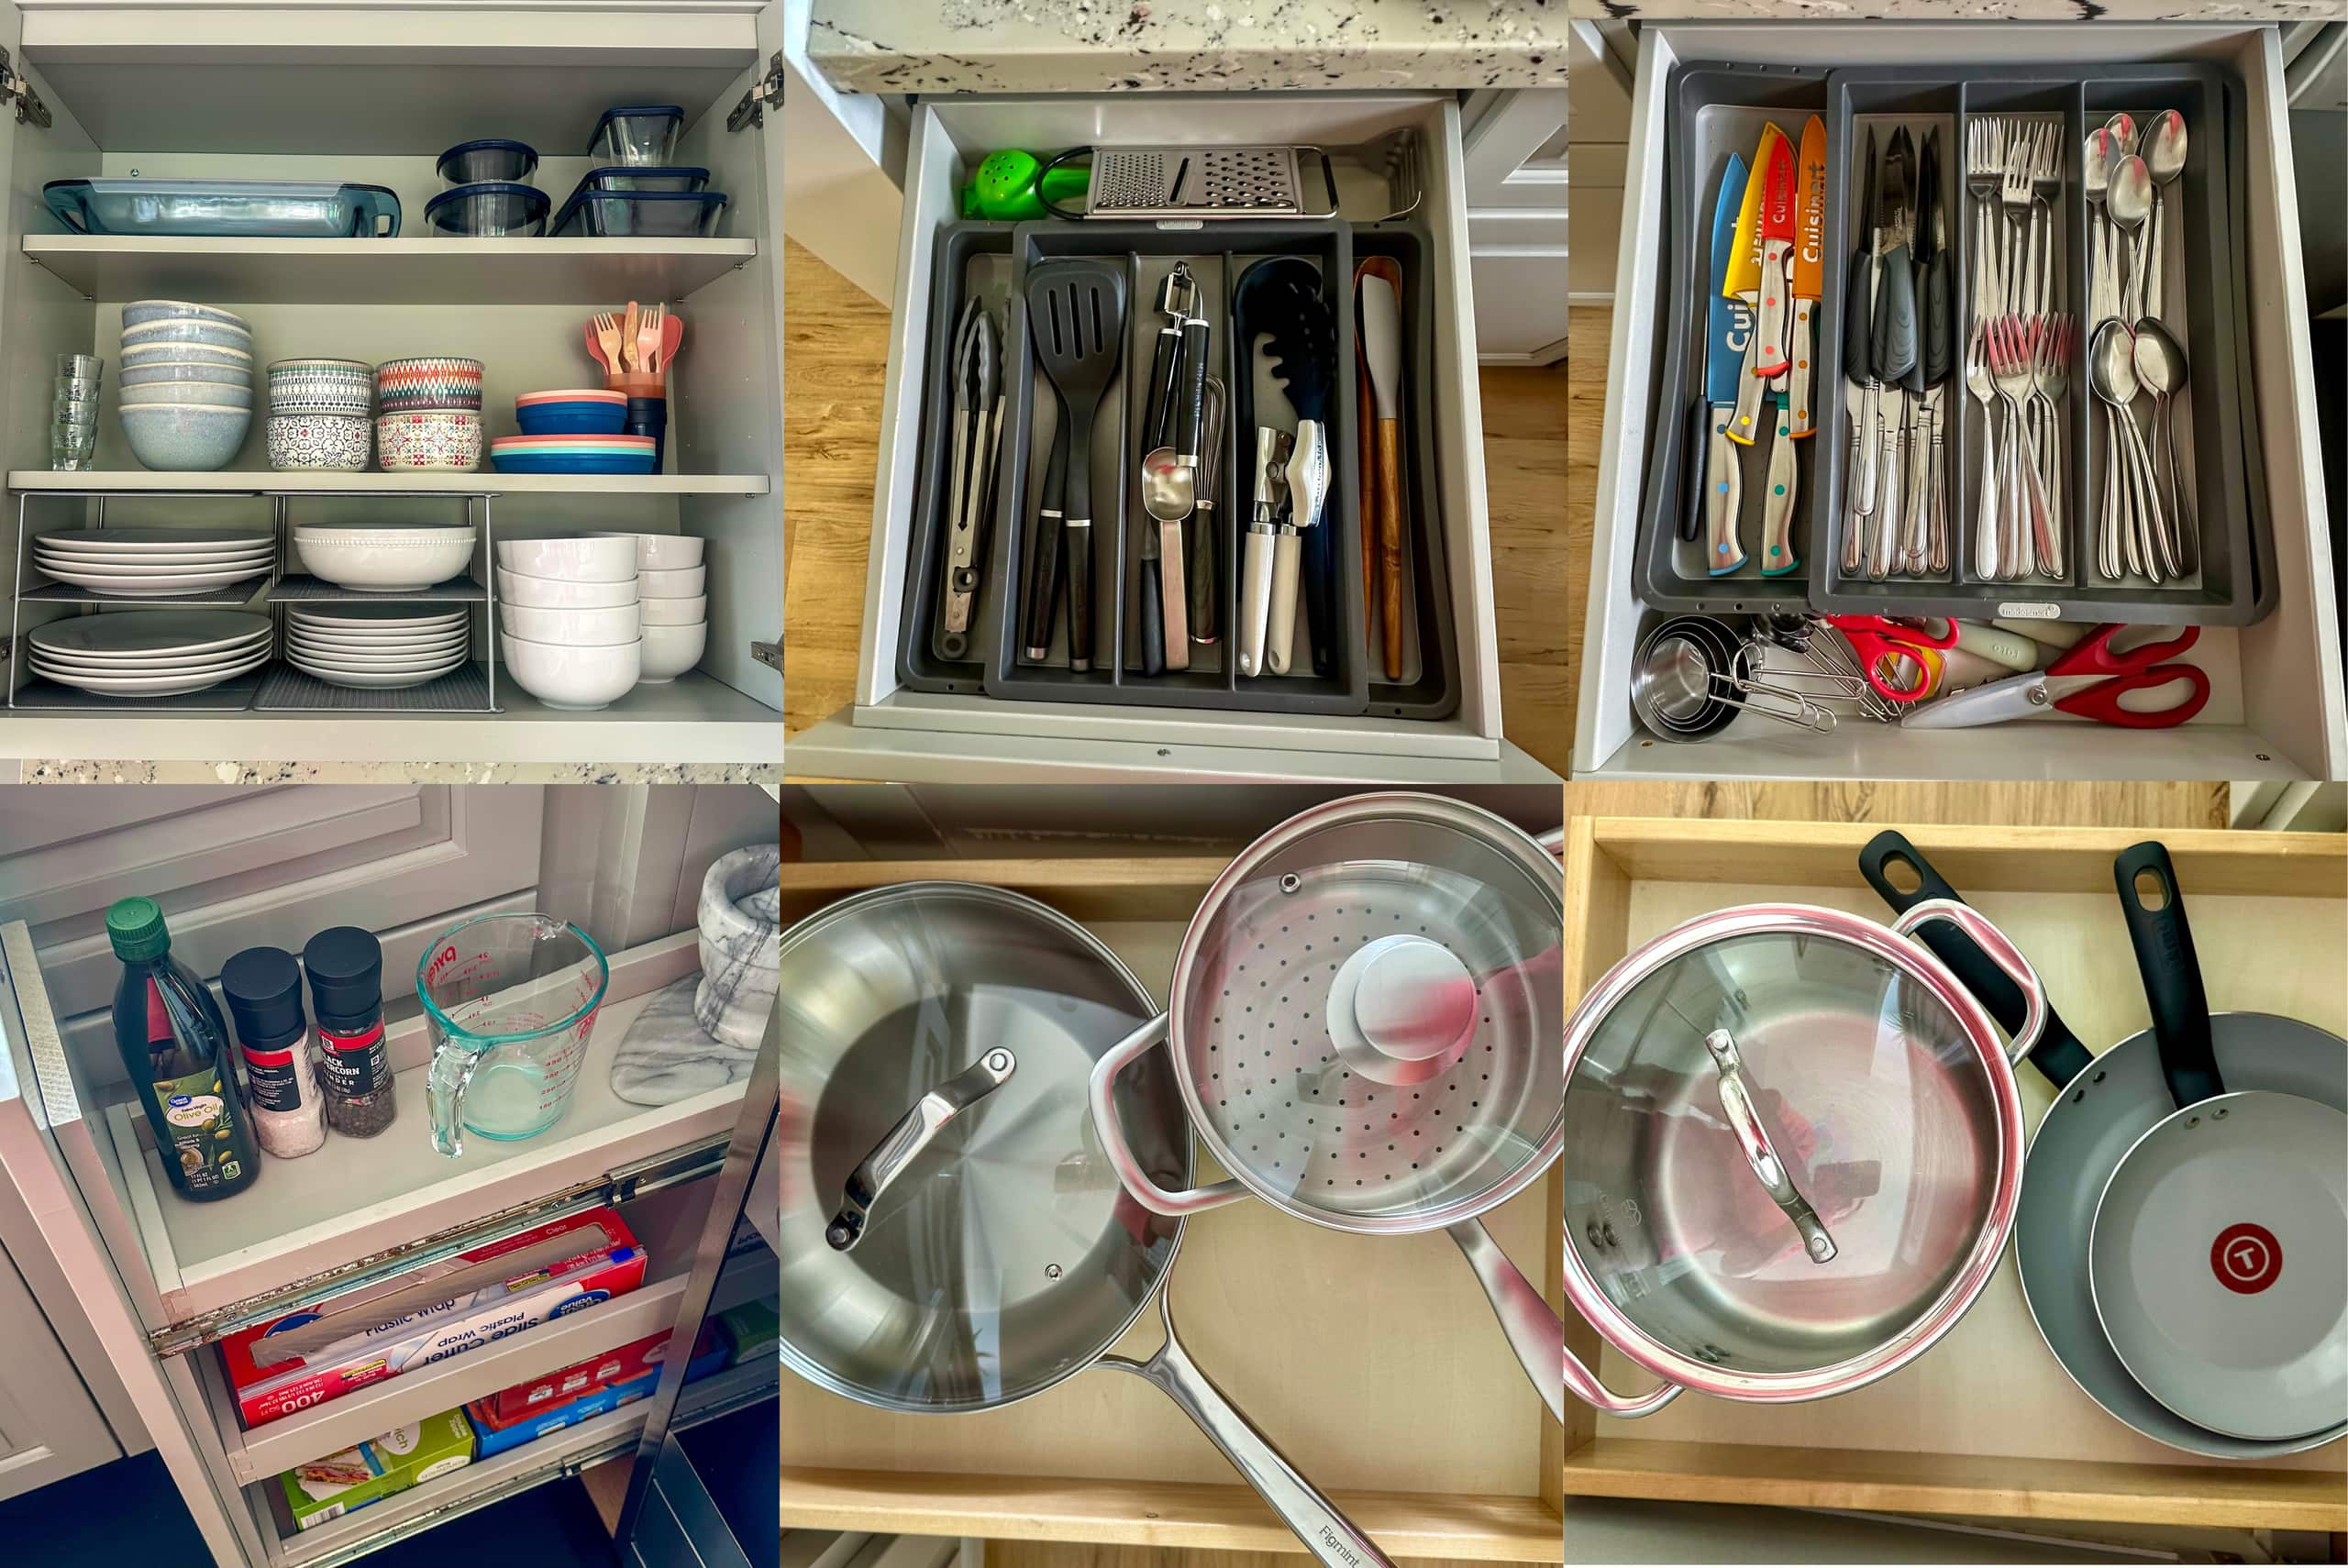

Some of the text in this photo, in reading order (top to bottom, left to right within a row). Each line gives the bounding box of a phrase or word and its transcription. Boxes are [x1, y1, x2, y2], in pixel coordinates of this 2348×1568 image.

[1802, 160, 1825, 263] Cuisinart
[174, 1103, 218, 1121] Olive Oil
[546, 1224, 567, 1235] Clear
[437, 1312, 525, 1347] Plastic Wrap
[282, 1390, 325, 1413] 400
[1319, 1525, 1360, 1568] Figmint
